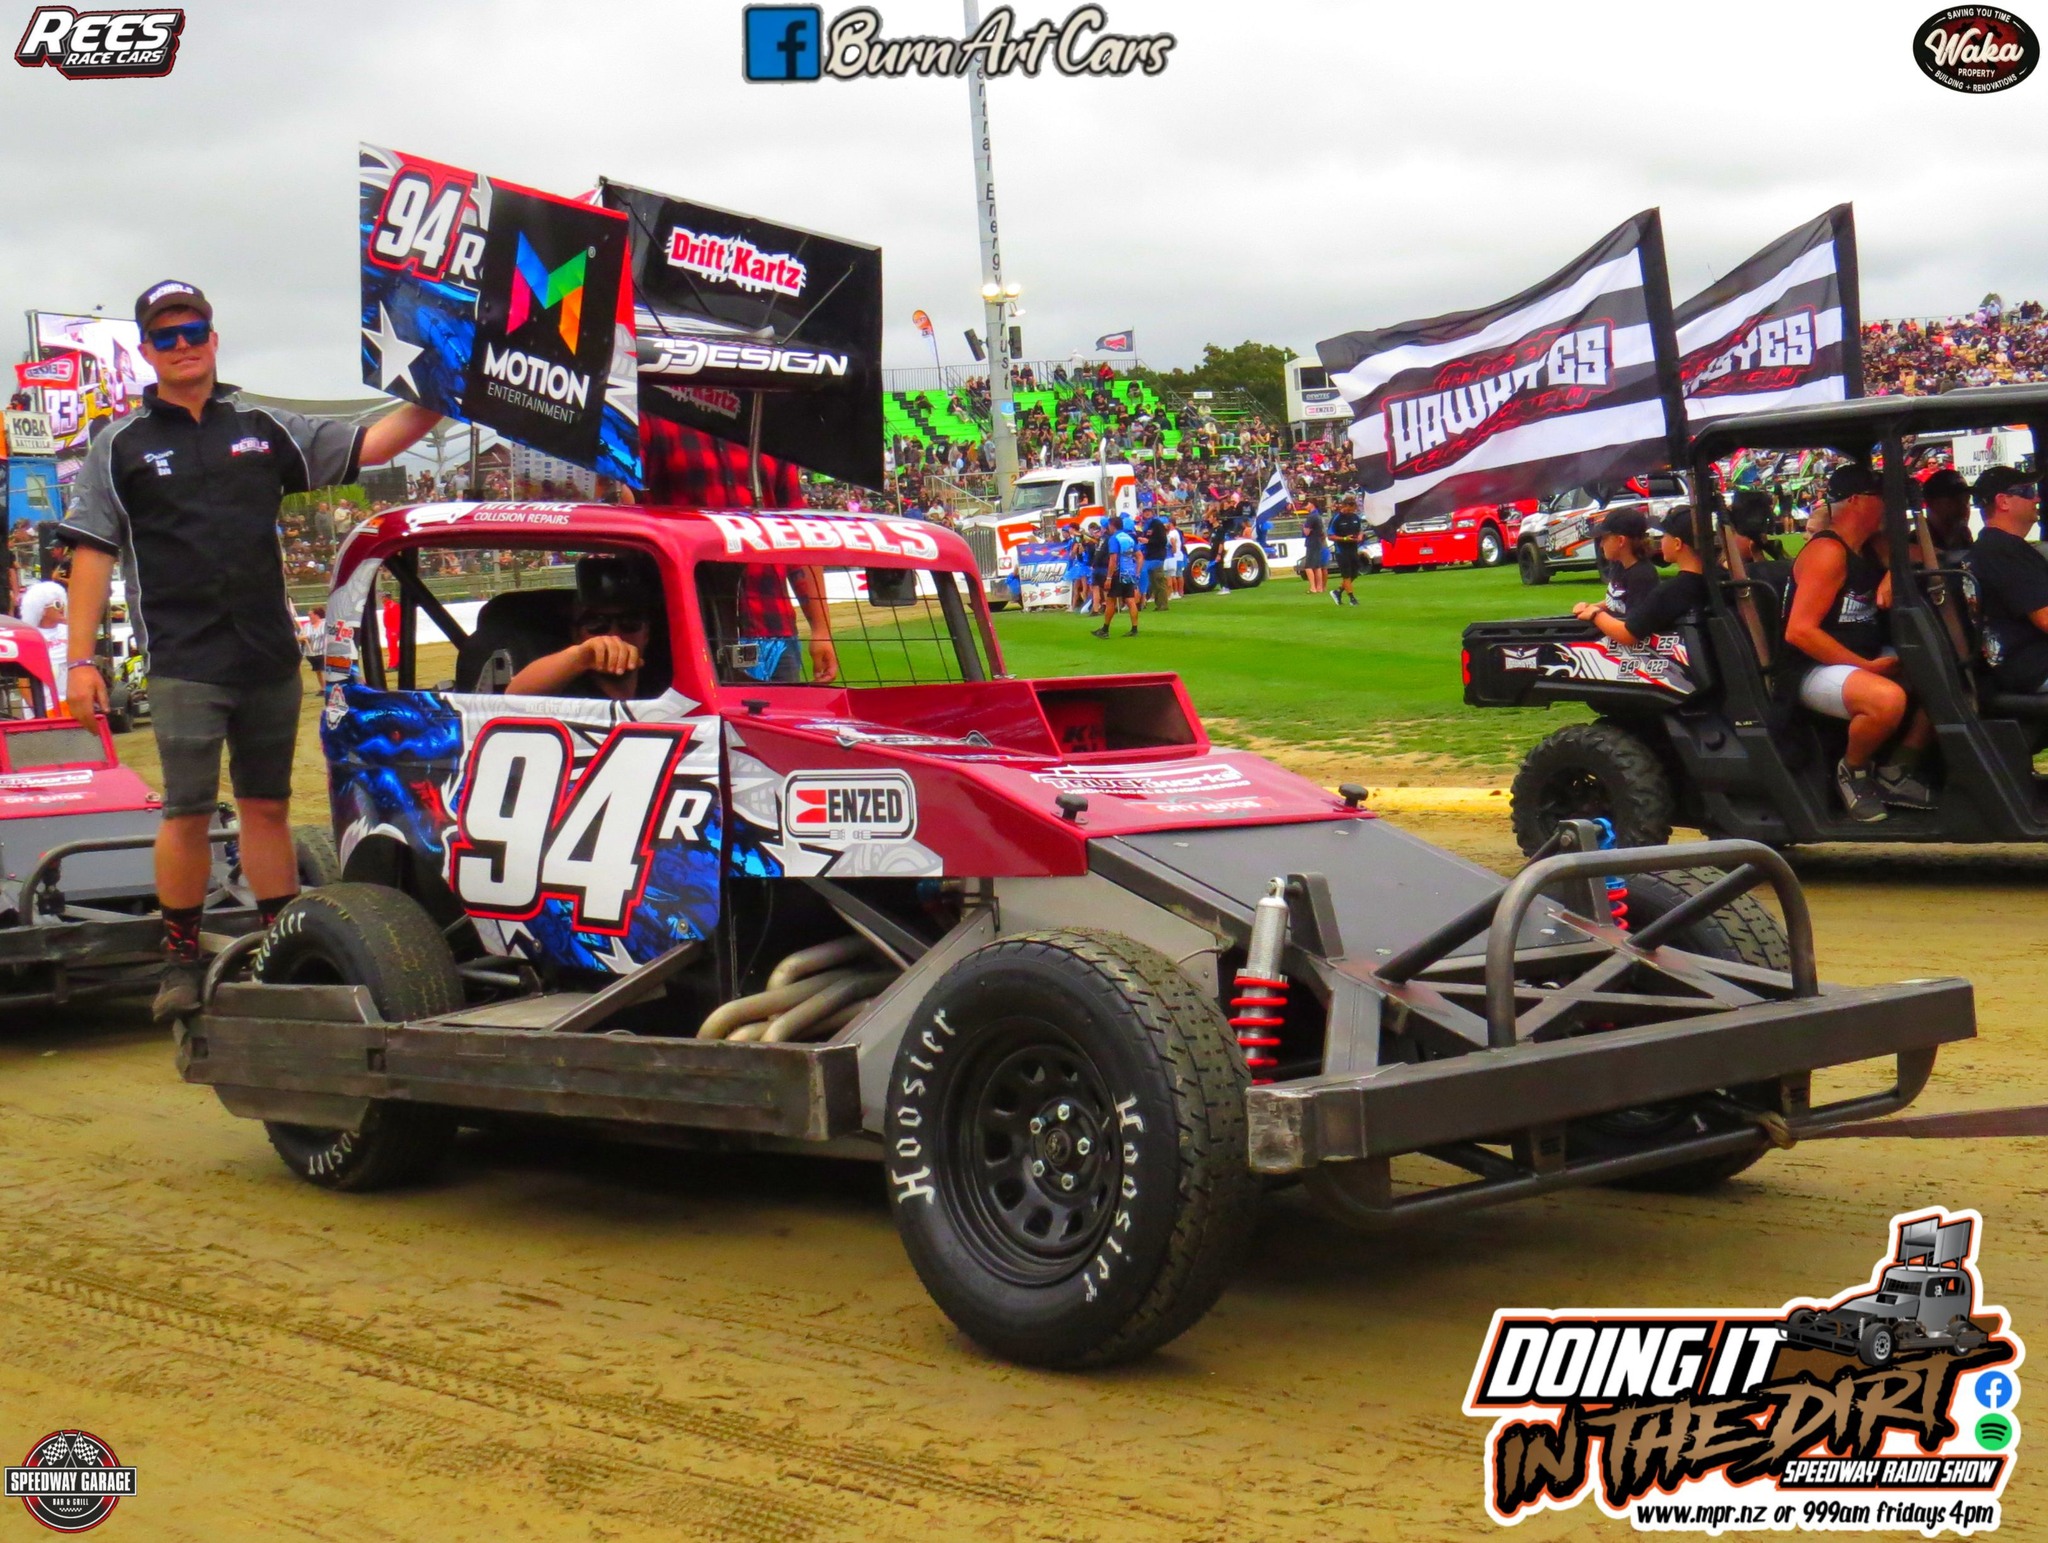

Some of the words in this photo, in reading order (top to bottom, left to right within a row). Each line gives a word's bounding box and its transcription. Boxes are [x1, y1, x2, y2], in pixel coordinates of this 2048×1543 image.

[670, 232, 727, 271] Drift
[732, 247, 802, 290] Kartz
[995, 302, 1009, 390] Trust
[483, 342, 590, 409] MOTION
[1389, 325, 1608, 467] HAWKYES
[487, 381, 576, 424] ENTERTAINMENT
[12, 417, 48, 437] KOBA
[231, 440, 269, 453] REBELS
[473, 511, 525, 523] COLLISION
[526, 513, 570, 526] REPAIRS
[705, 513, 940, 560] REBELS
[828, 788, 904, 823] ENZED
[1063, 787, 1155, 795] MECHANICAL
[891, 1008, 956, 1205] Hoosier
